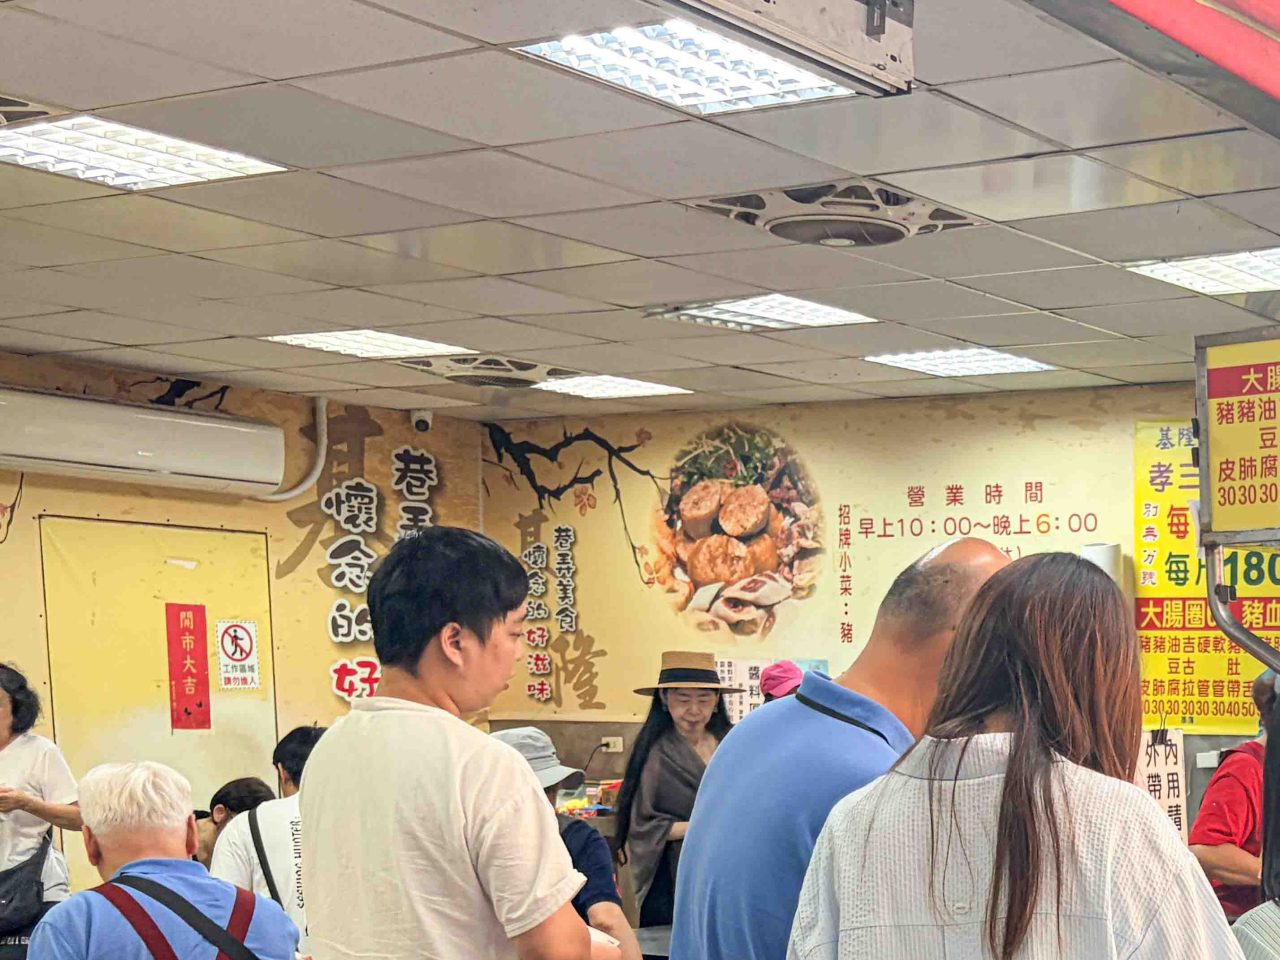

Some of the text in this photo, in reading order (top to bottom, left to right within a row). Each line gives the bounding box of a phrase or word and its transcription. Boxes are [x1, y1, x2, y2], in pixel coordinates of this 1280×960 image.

[907, 481, 1044, 508] 營業時間
[180, 610, 197, 695] 開市大吉
